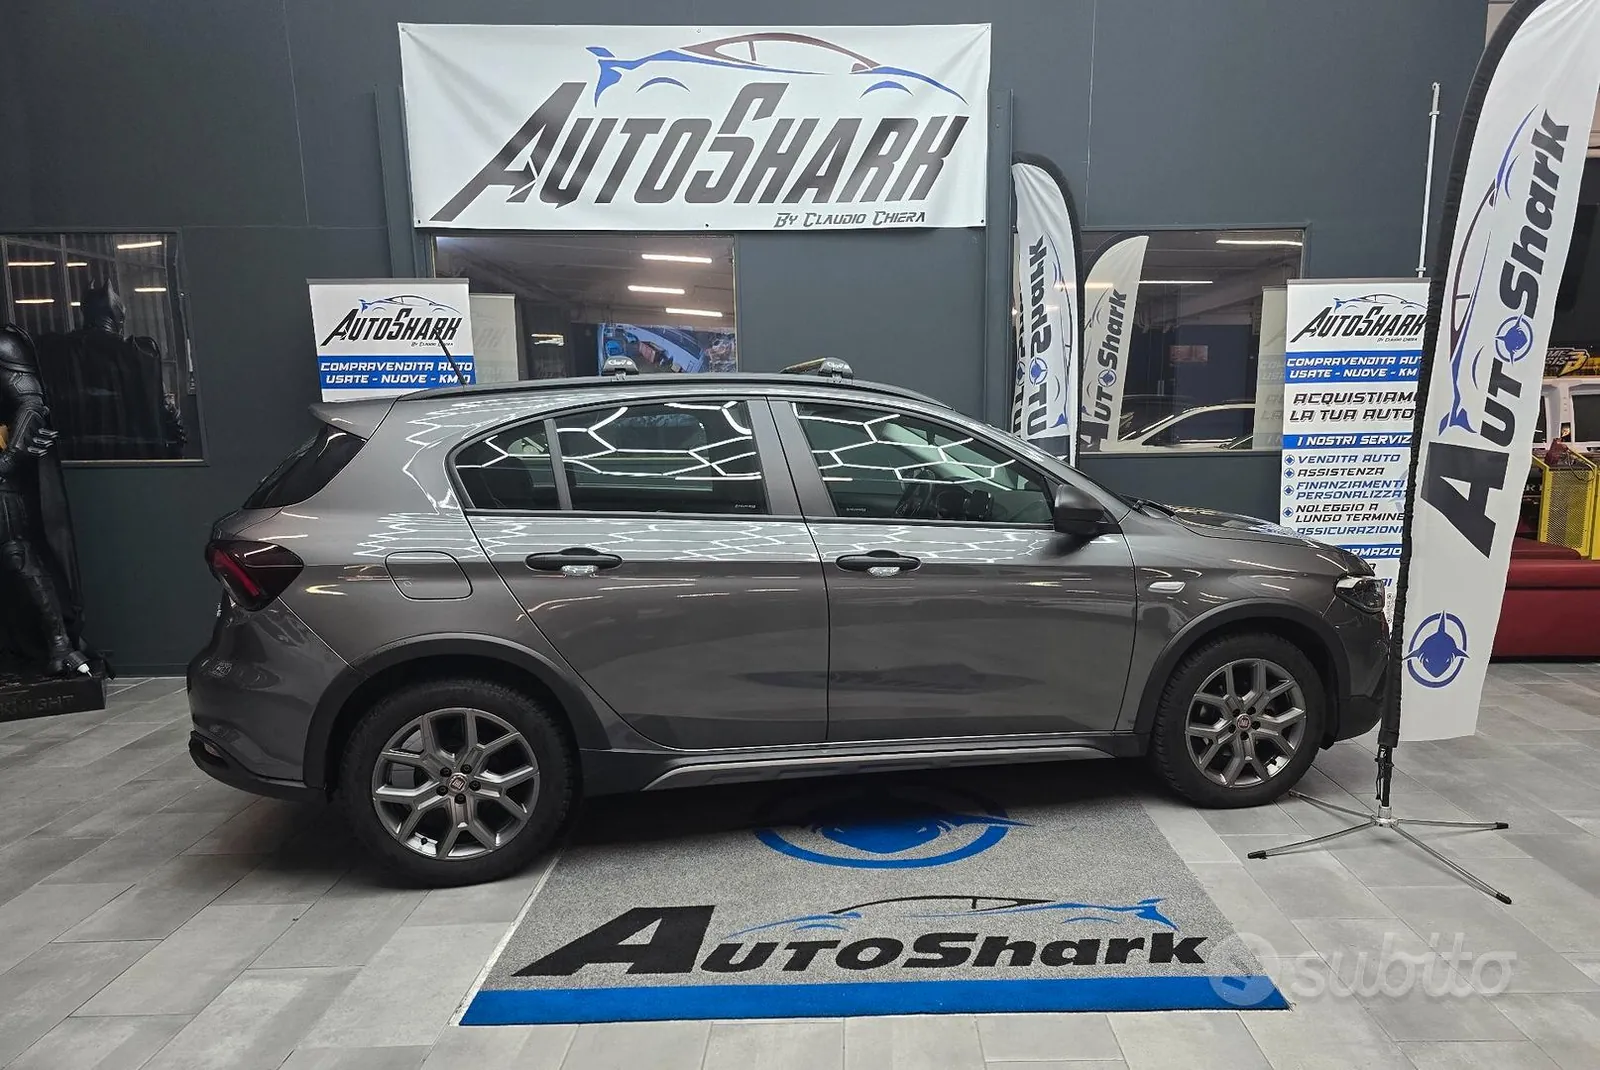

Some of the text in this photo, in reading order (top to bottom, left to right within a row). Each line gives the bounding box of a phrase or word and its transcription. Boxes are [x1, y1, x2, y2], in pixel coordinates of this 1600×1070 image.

[430, 82, 969, 223] AUTOSHARK
[774, 210, 926, 228] BY CLAUDIO CHIERA
[320, 308, 462, 346] AUTOSHARK
[1290, 306, 1427, 343] AUTOSHARK
[320, 362, 434, 371] COMPRAVENDITA
[1287, 356, 1397, 367] COMPRAVENDITA
[1290, 369, 1332, 378] USATE
[1343, 368, 1388, 378] NUOVE
[1398, 367, 1418, 377] KM
[326, 374, 369, 384] USATE
[381, 374, 427, 384] NUOVE
[1293, 391, 1416, 405] ACQUISTIAM
[1290, 408, 1415, 422] LA TUA AUTO
[1306, 435, 1356, 446] NOSTRI
[1360, 435, 1413, 445] SERVIZ
[1299, 454, 1401, 464] VENDITA AUTO
[1297, 467, 1385, 477] ASSISTENZA
[1297, 480, 1405, 490] FINANZIAMENTI
[1295, 503, 1379, 513] NOLEGGIO A
[1295, 512, 1405, 523] LUNGO TERMINE
